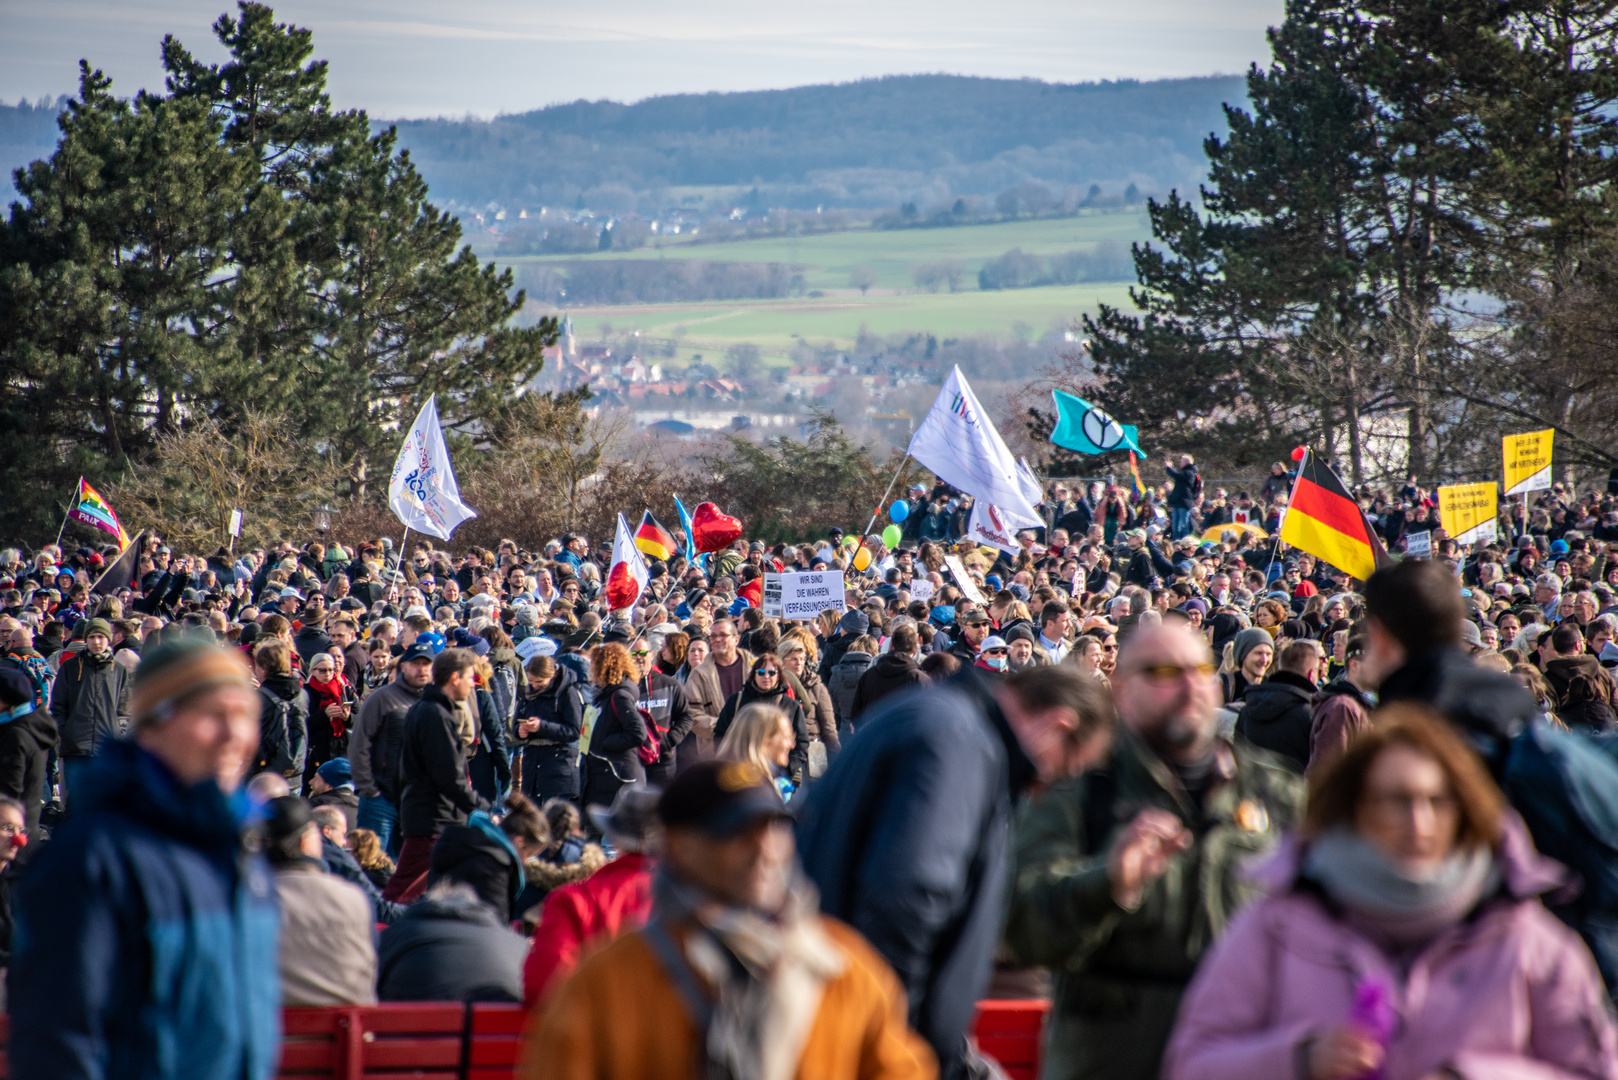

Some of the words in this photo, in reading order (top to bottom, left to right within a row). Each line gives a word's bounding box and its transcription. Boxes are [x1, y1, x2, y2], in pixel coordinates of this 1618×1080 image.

[79, 512, 99, 526] PAIX
[799, 576, 810, 584] WIR
[811, 575, 823, 584] SIND
[797, 589, 805, 598] DIE
[806, 588, 830, 597] WAHREN
[785, 599, 844, 613] VERFASSUNGSHÜTER
